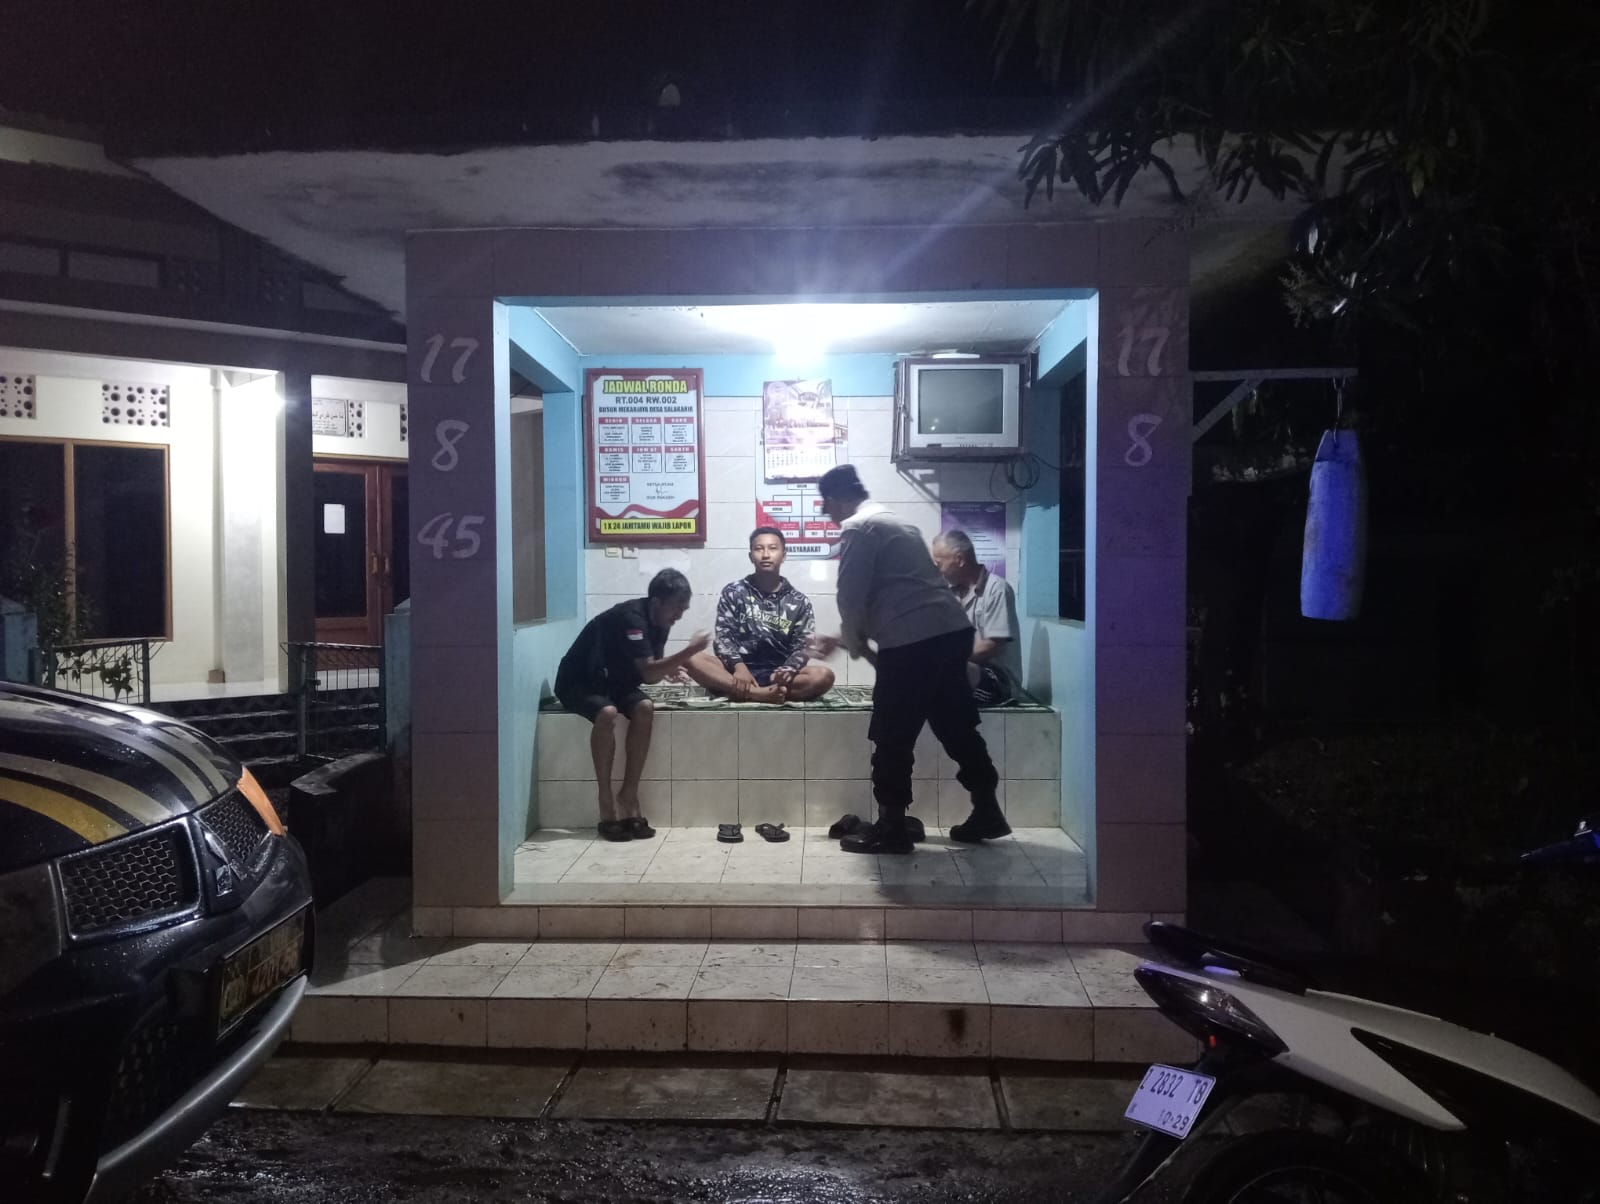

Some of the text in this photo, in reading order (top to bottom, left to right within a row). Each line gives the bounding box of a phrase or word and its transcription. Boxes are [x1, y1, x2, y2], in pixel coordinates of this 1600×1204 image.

[420, 333, 479, 384] 17
[1118, 325, 1170, 376] 17
[603, 379, 689, 394] JADWAL RONDA
[615, 396, 678, 404] RT.004 RW.002
[431, 419, 470, 472] 8
[1124, 413, 1163, 467] 8
[417, 512, 485, 559] 45
[1150, 1071, 1184, 1098] 2832
